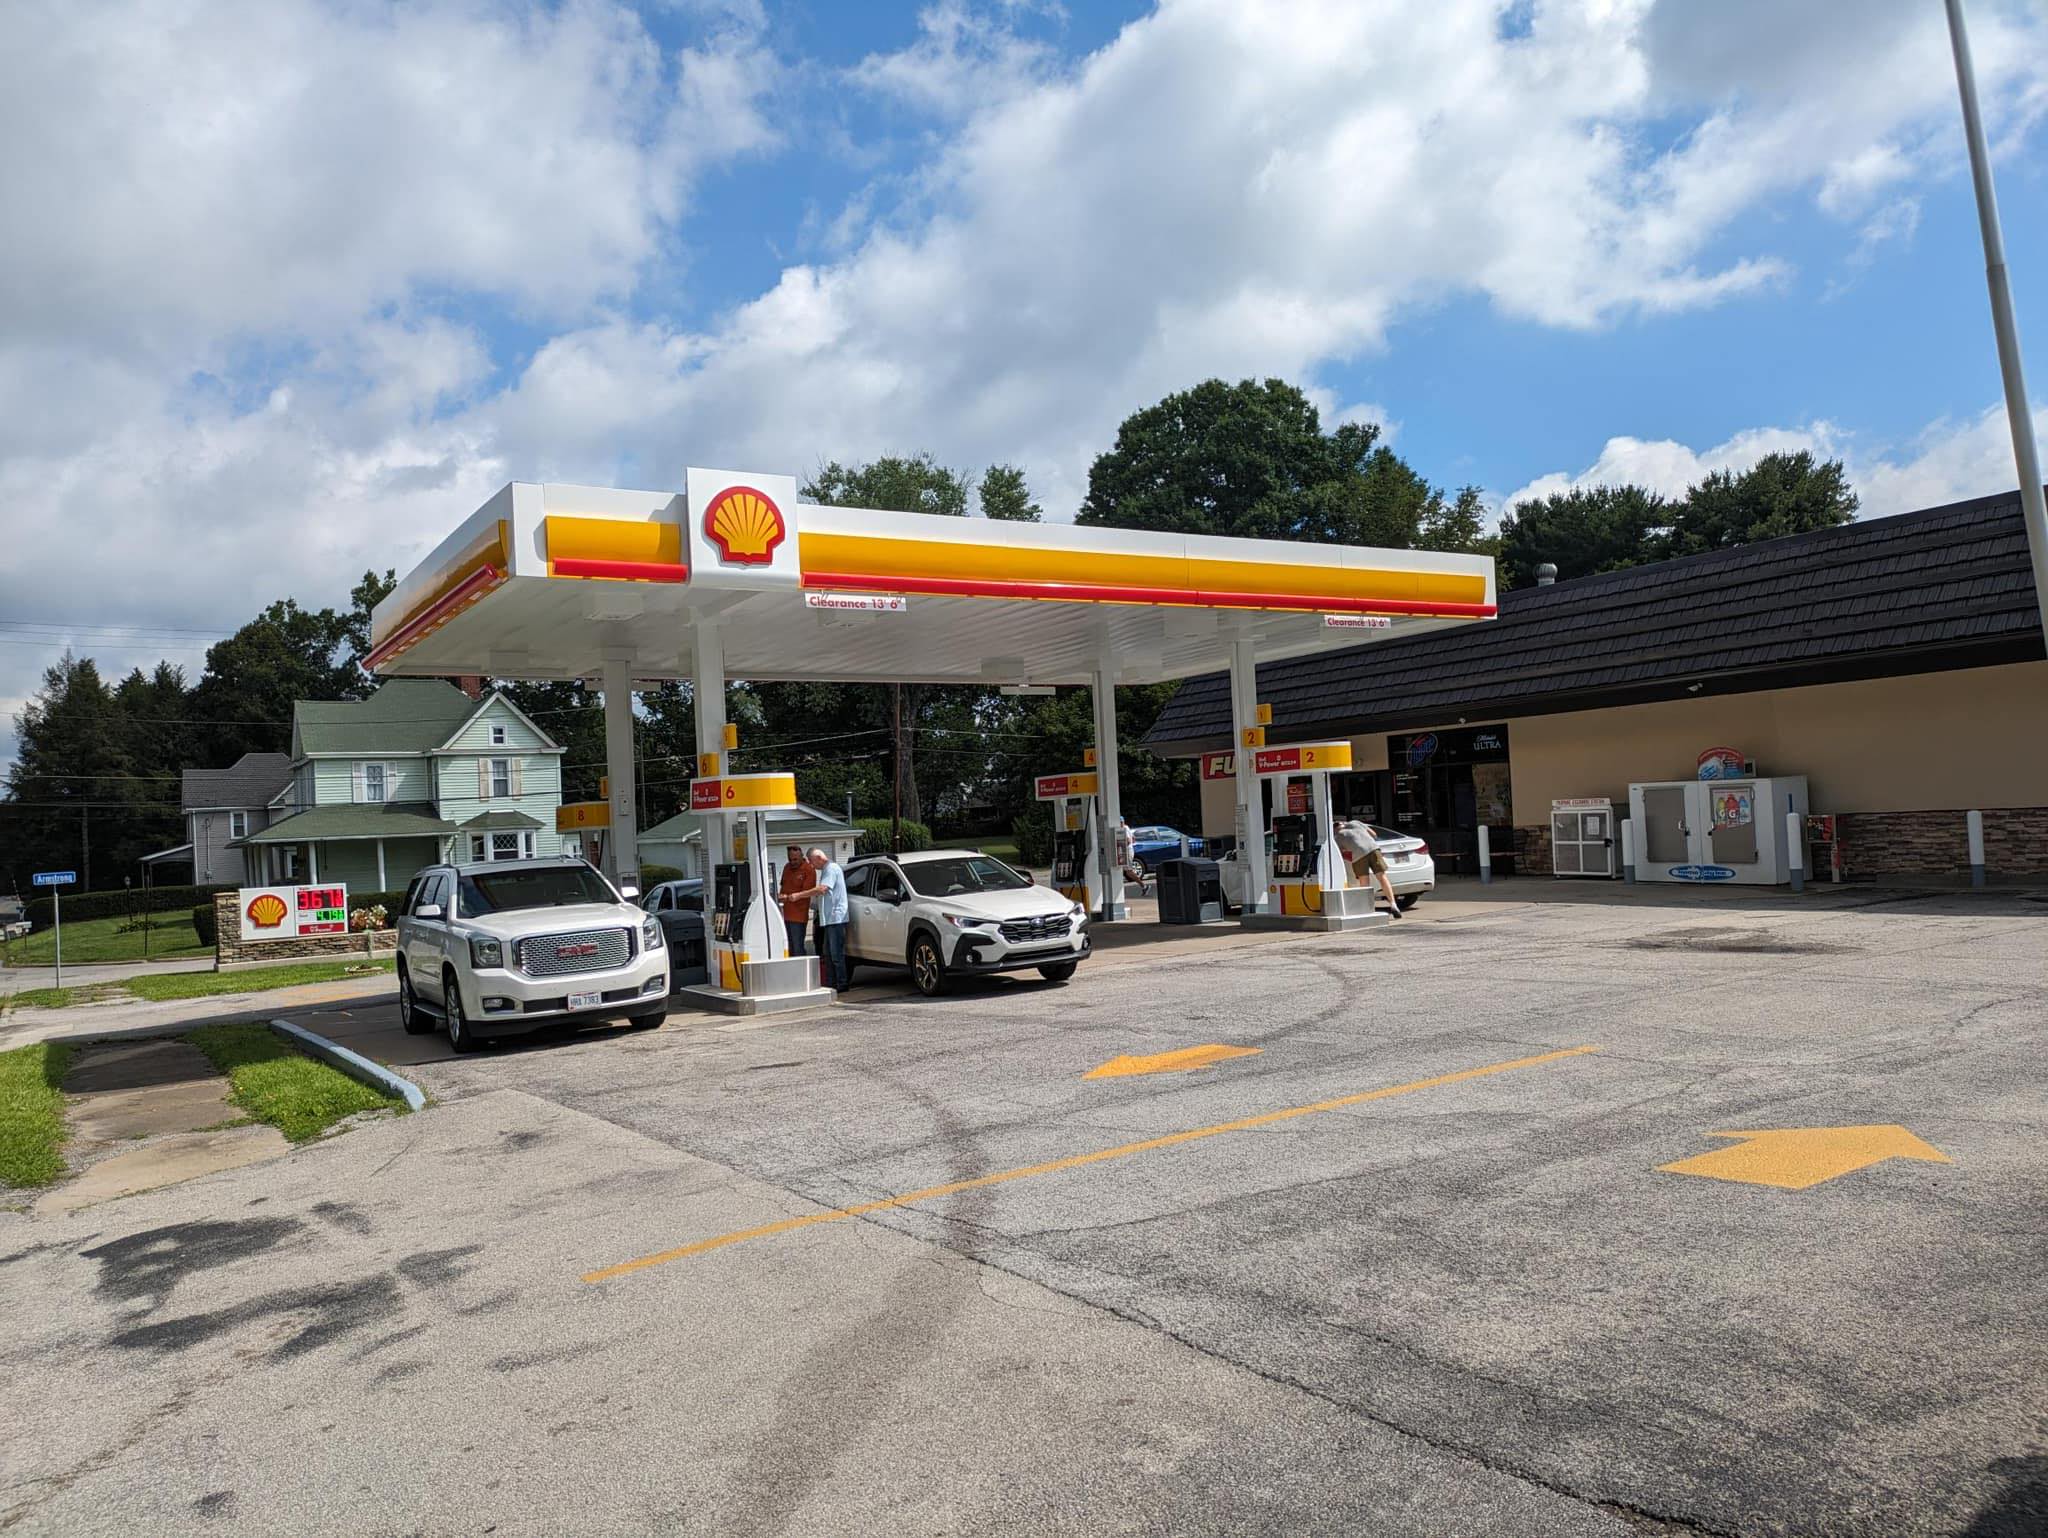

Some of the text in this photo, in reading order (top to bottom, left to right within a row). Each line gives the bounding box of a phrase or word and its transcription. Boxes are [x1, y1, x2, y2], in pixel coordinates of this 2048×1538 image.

[809, 596, 867, 609] Clearance
[1327, 617, 1365, 627] Clearance
[1247, 731, 1255, 744] 2
[1473, 740, 1502, 751] ULTRA
[1305, 751, 1315, 763] 2
[702, 757, 708, 773] 6
[725, 785, 736, 800] 6
[577, 809, 585, 821] 8
[1728, 809, 1737, 818] G
